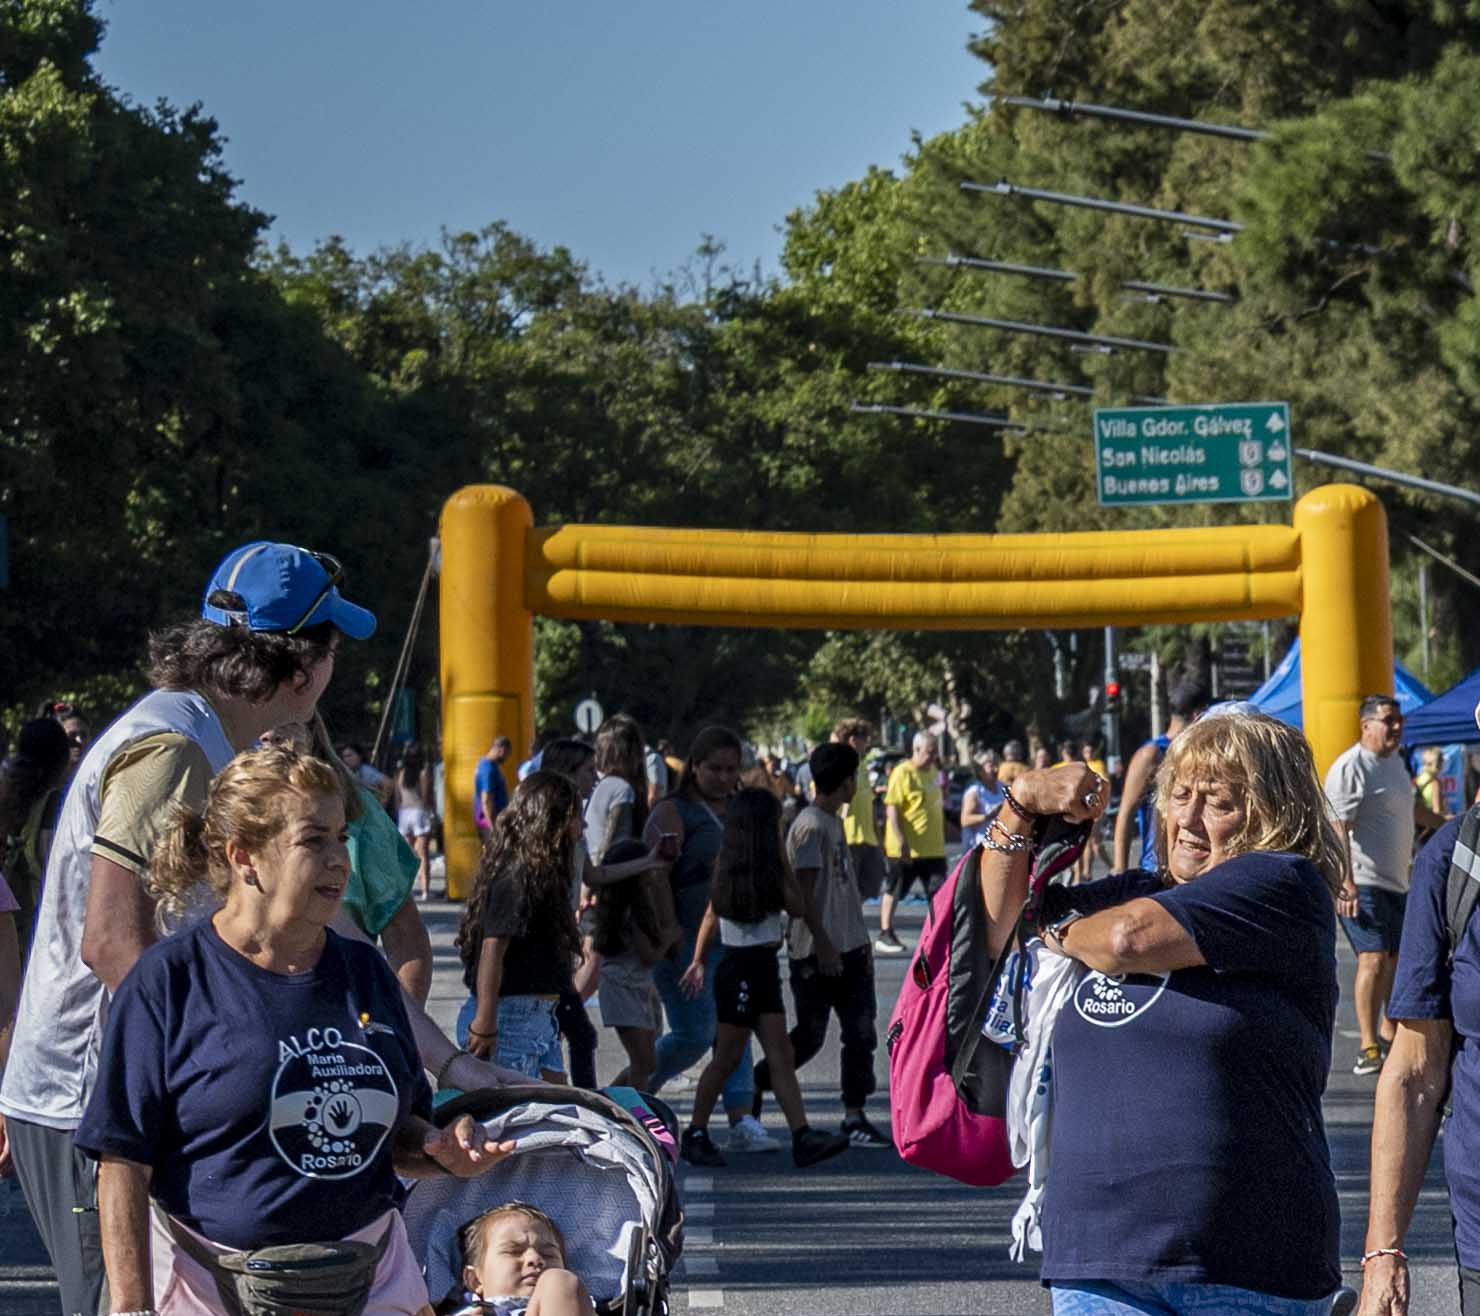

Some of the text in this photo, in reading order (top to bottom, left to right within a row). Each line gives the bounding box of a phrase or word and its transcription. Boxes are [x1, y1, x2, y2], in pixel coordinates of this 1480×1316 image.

[1101, 415, 1253, 438] Villa Gdor. Gálvez
[1102, 447, 1136, 467] San
[1141, 446, 1206, 467] Nicolás
[1104, 476, 1169, 496] Buenos
[1175, 474, 1219, 495] Aires
[1083, 998, 1136, 1015] Rosario
[278, 1027, 342, 1063] ALCO
[312, 1063, 384, 1079] Auxiliadora
